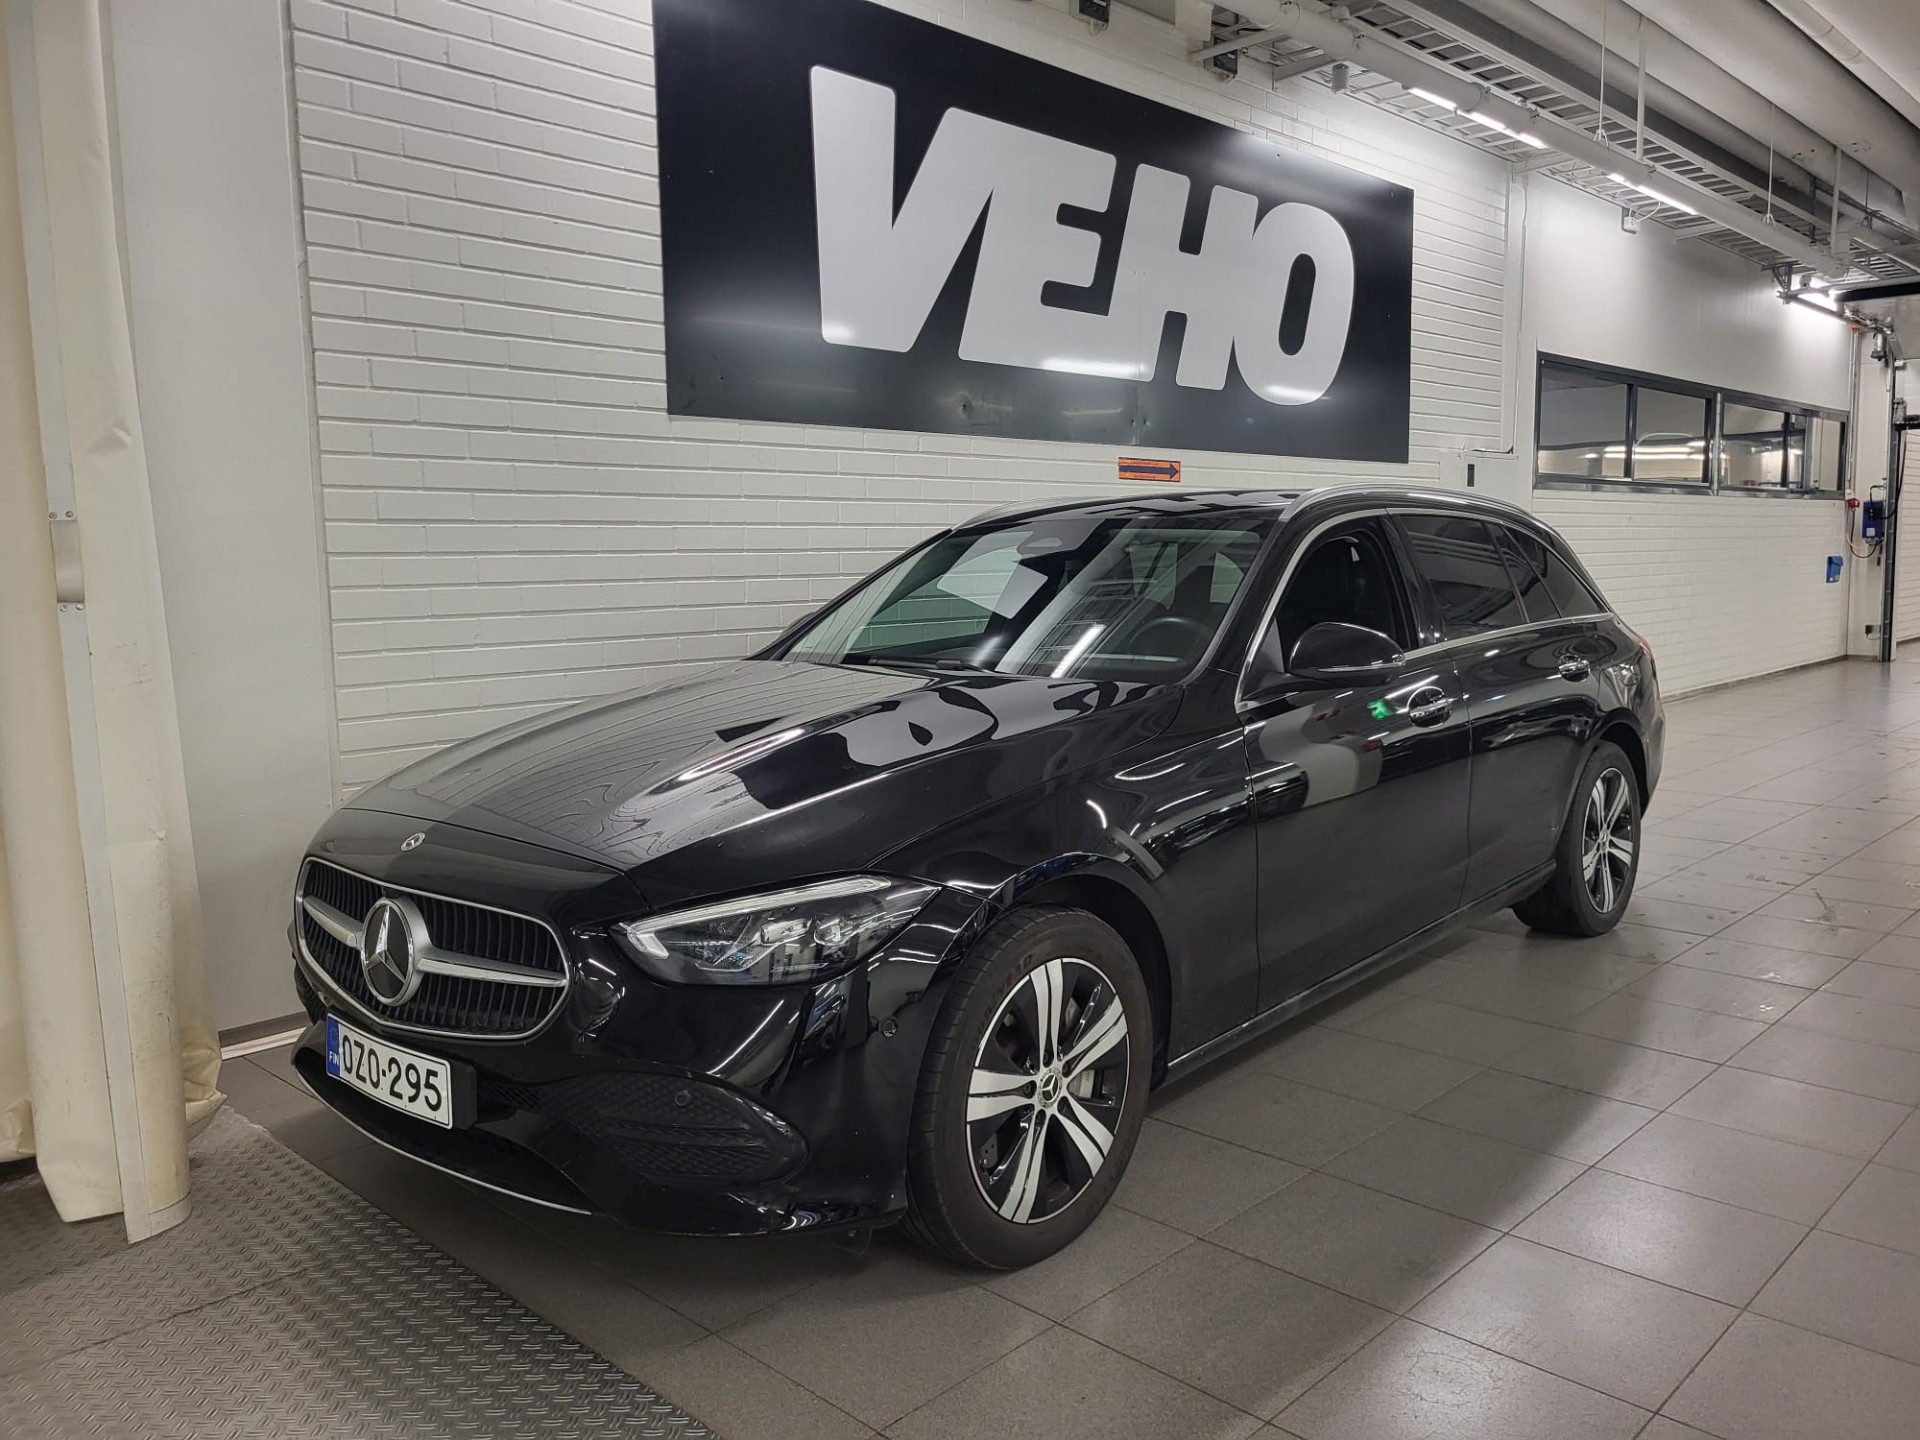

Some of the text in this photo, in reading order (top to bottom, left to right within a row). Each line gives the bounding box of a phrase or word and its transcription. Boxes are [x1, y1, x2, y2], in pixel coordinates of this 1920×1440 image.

[810, 65, 1355, 406] VEHO
[329, 1050, 340, 1066] FIN
[342, 1035, 442, 1112] OZO-295
